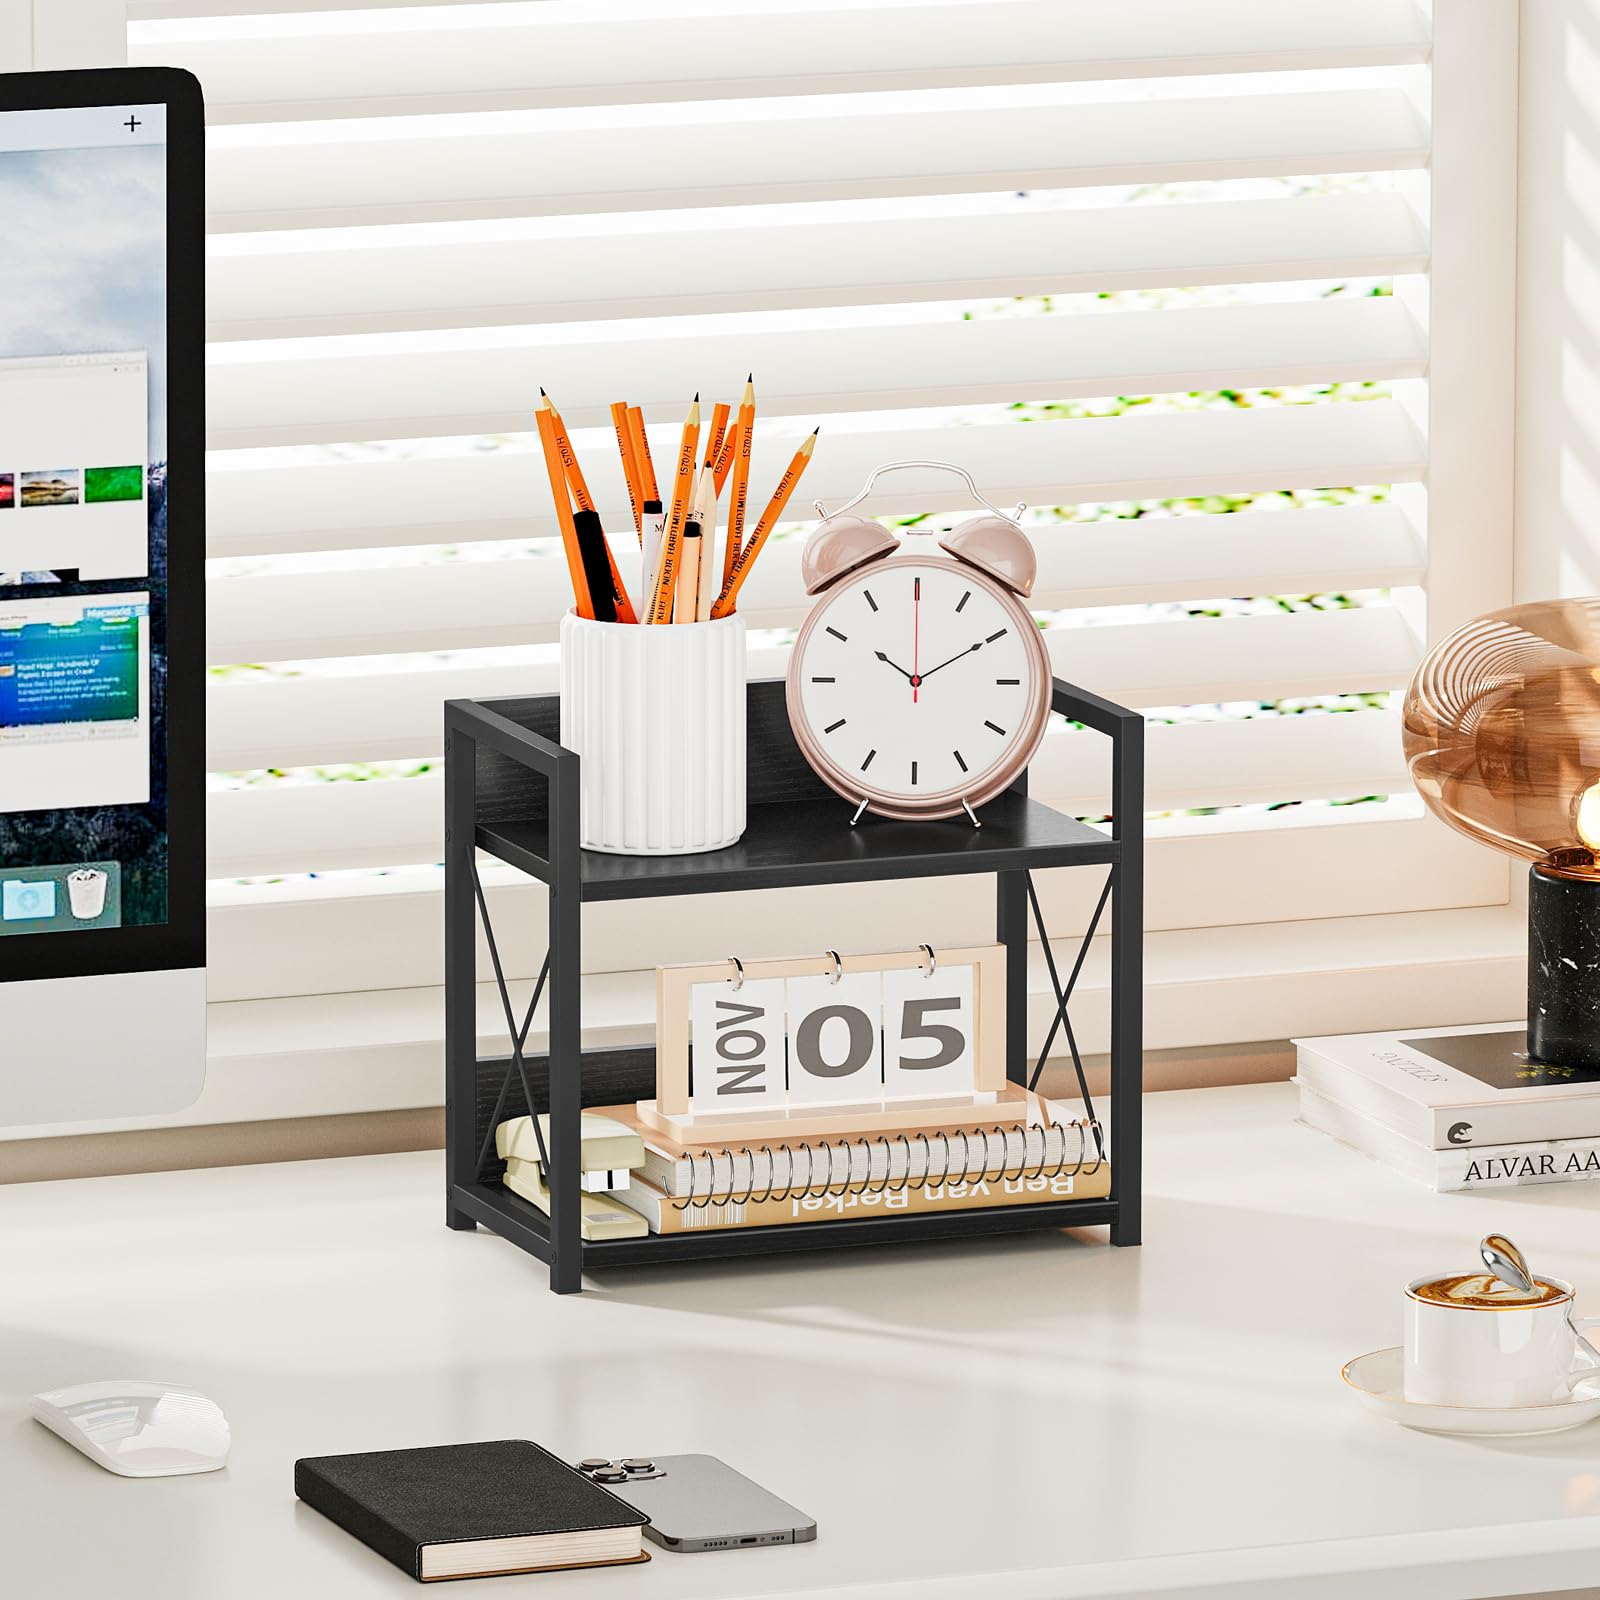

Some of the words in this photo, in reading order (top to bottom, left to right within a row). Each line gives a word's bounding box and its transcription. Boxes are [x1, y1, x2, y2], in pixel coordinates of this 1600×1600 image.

[557, 436, 574, 467] 1570/H
[742, 427, 753, 458] 1570/H
[680, 445, 693, 476] 1570/H
[714, 444, 732, 474] 1570/H
[667, 500, 683, 556] HARDTMUTH
[719, 575, 737, 601] NOOR
[734, 521, 766, 574] HARDTMUTH
[773, 471, 795, 501] 1570/H
[663, 559, 674, 587] NOOR
[715, 1000, 767, 1096] NOV
[1004, 1171, 1075, 1196] Ben
[1463, 1154, 1557, 1182] ALVAR
[791, 1184, 909, 1218] Berkel
[923, 1179, 991, 1202] van
